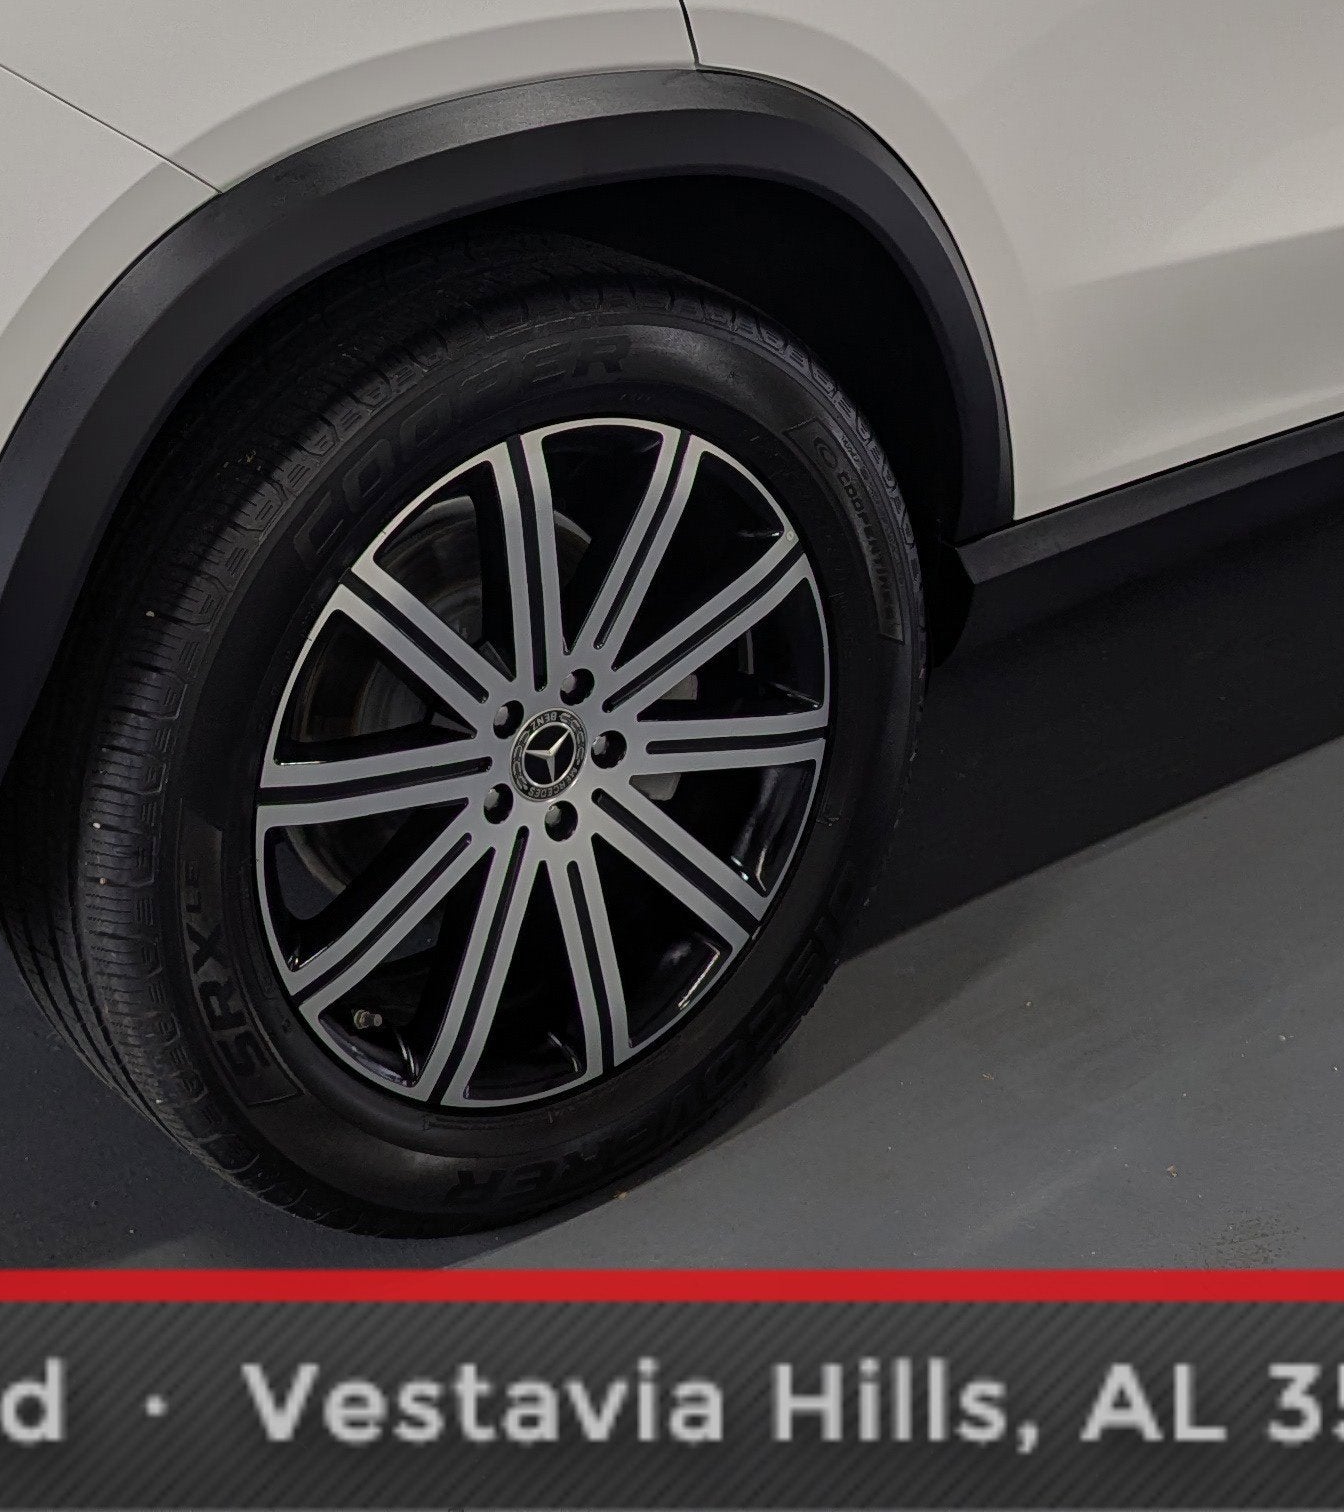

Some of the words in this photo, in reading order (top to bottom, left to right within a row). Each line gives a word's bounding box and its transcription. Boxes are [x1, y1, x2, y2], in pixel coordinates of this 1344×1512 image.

[292, 333, 634, 562] COOPER
[529, 710, 558, 731] BENZ
[527, 767, 579, 799] MERCEDES
[186, 922, 270, 1080] SRX
